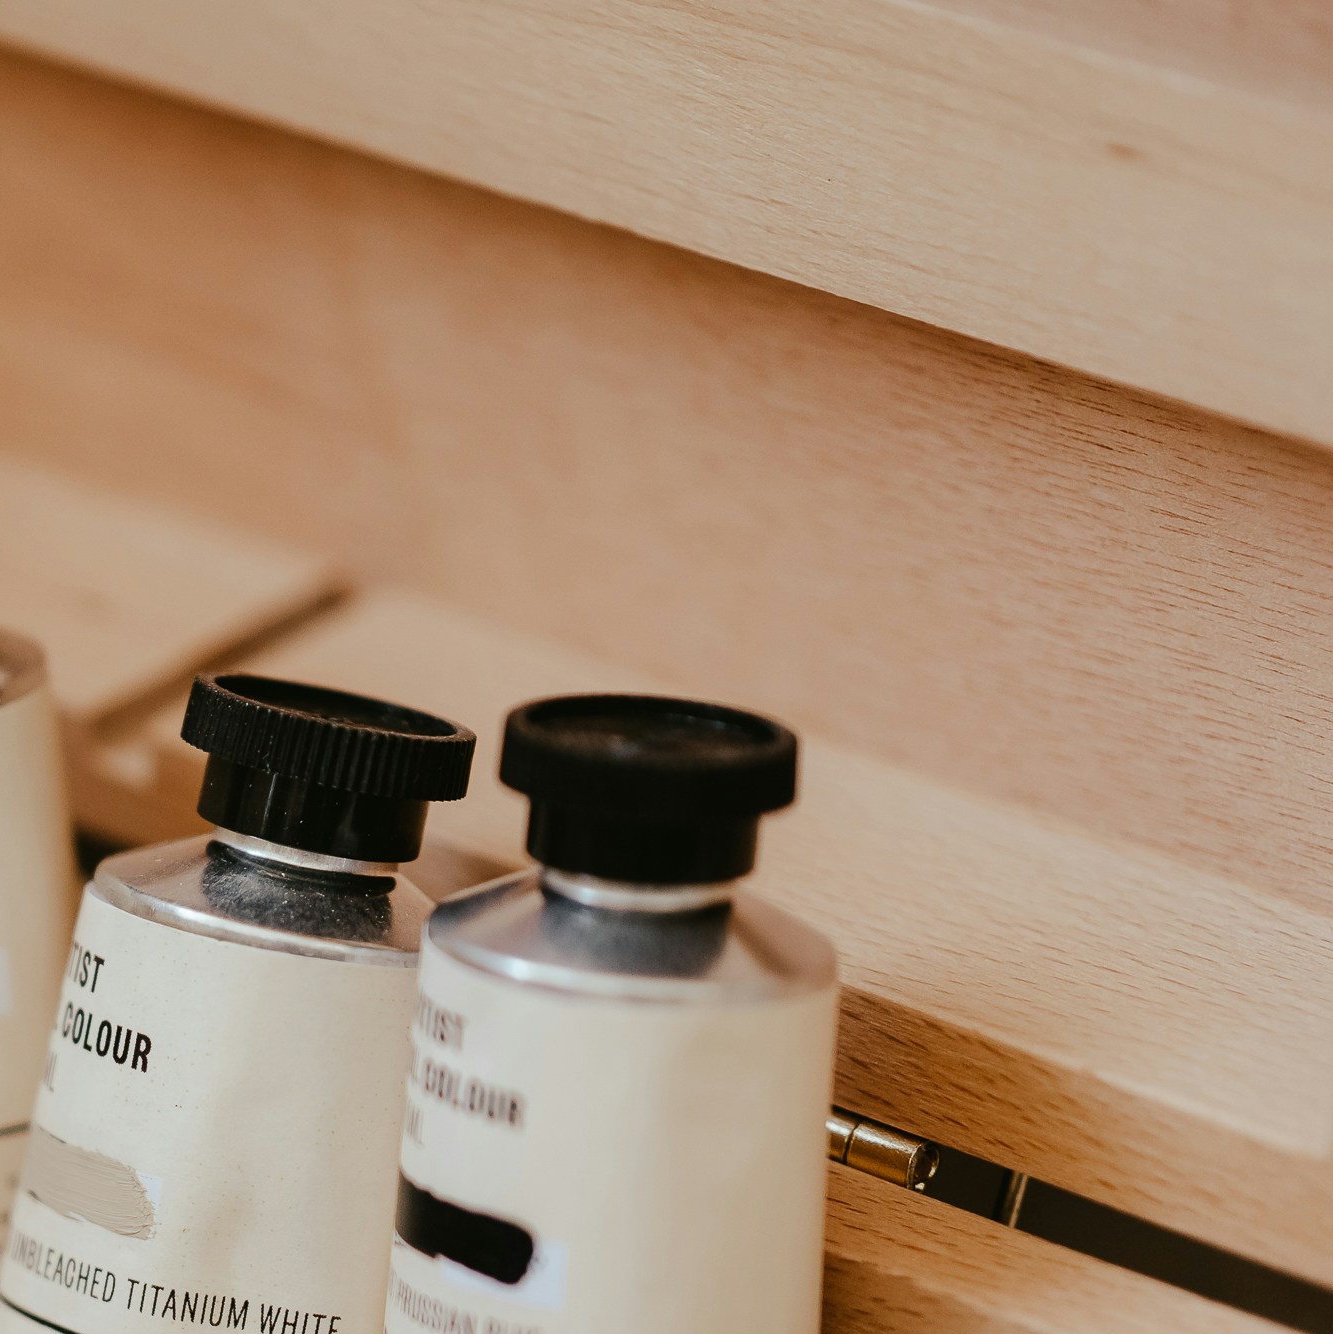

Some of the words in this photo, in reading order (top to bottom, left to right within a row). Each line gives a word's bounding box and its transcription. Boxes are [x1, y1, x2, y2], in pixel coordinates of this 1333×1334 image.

[67, 940, 105, 993] TIST
[61, 1000, 152, 1073] COLOUR
[127, 1277, 250, 1331] TITANIUM
